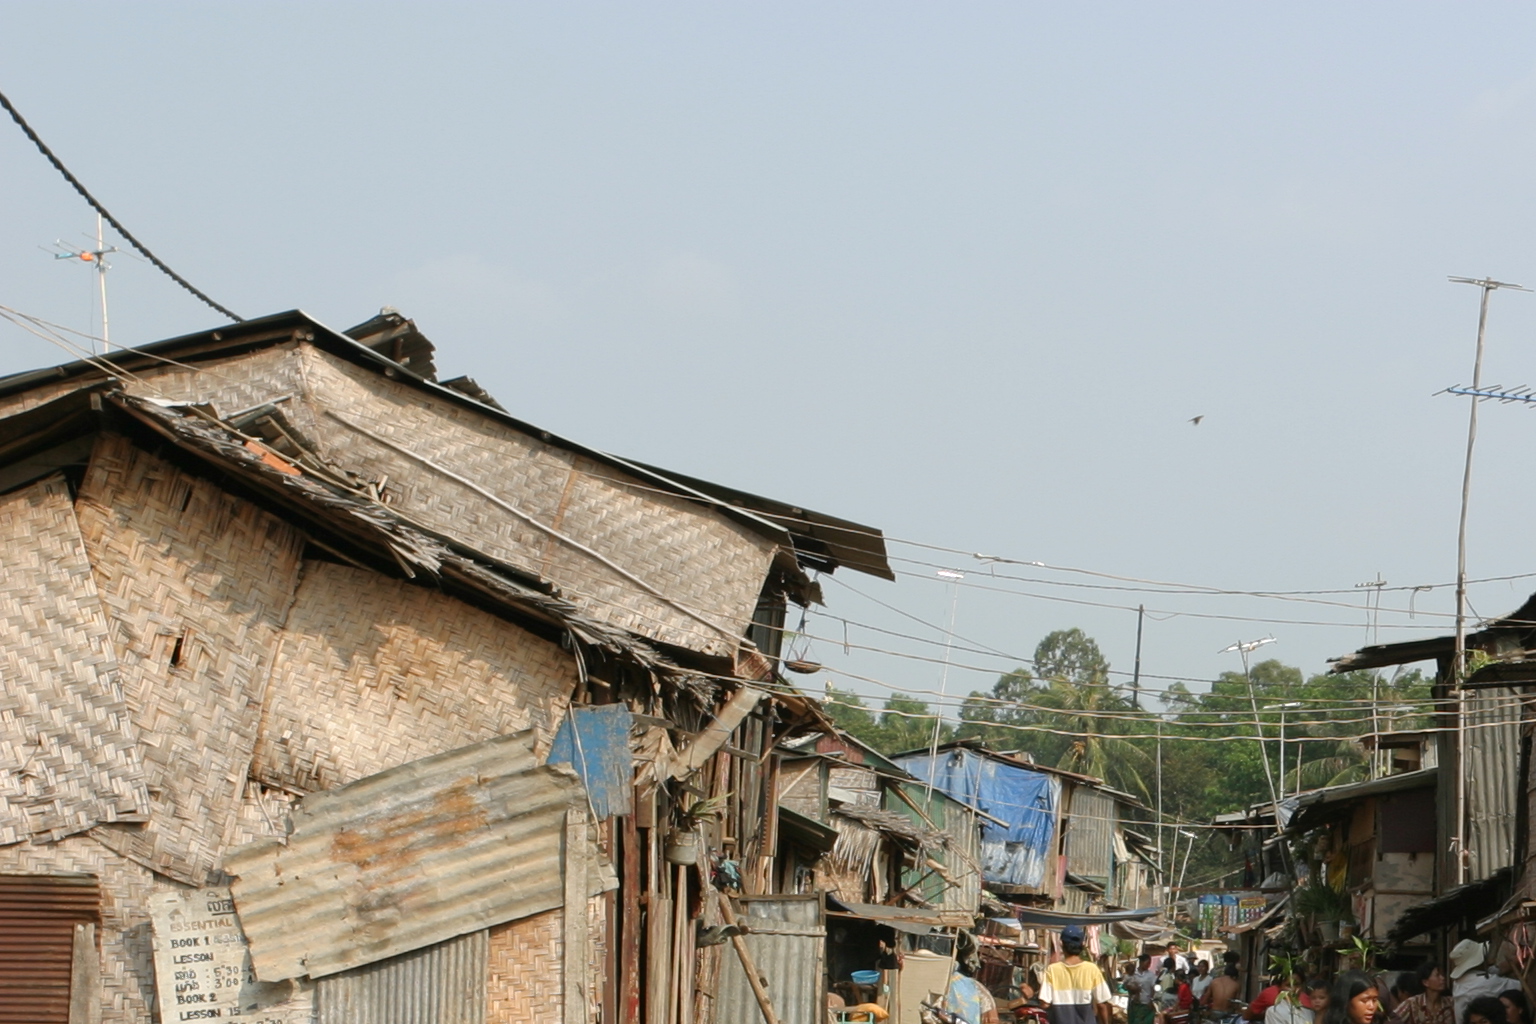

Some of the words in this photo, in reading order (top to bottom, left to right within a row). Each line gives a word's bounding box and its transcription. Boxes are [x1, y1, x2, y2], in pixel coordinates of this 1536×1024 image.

[169, 918, 232, 932] ESSENTIAL
[170, 937, 200, 949] BOOK
[204, 936, 210, 945] 1
[173, 952, 214, 964] LESSON
[176, 993, 207, 1005] BOOK
[209, 992, 217, 1002] 2
[179, 1008, 221, 1021] LESSON
[228, 1007, 241, 1016] 15
